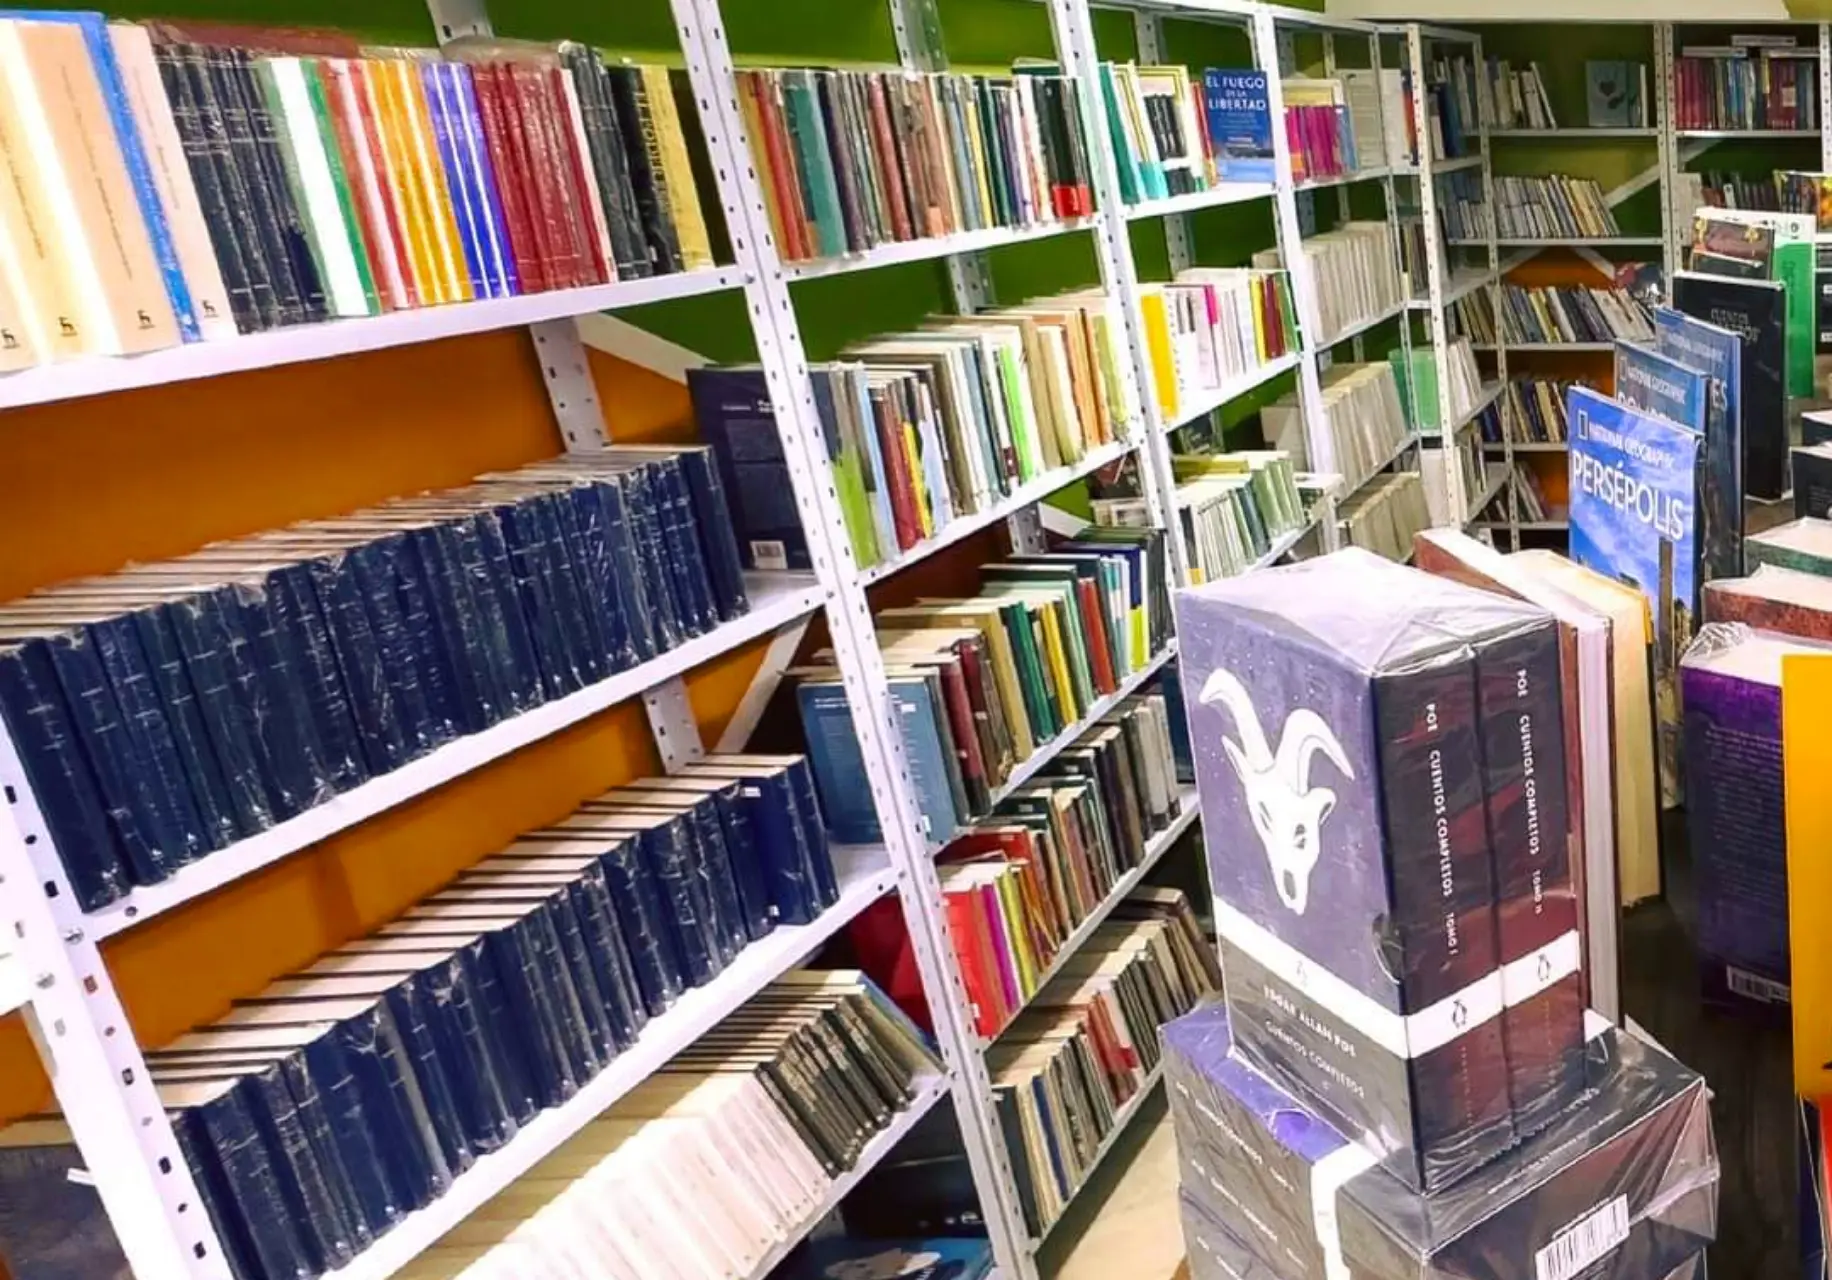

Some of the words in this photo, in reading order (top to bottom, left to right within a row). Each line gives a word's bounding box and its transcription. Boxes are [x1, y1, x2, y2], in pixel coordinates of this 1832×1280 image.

[1206, 76, 1219, 88] EL
[1222, 77, 1264, 89] FUEGO
[1208, 98, 1266, 111] LIBERTAD
[1571, 448, 1685, 541] PERSÉPOLIS
[1516, 668, 1529, 697] POE
[1426, 702, 1439, 732] POE
[1519, 714, 1535, 777] CUENTOS
[1429, 749, 1447, 815] CUENTOS
[1524, 778, 1540, 856] COMPLETOS
[1436, 817, 1454, 897] COMPLETOS
